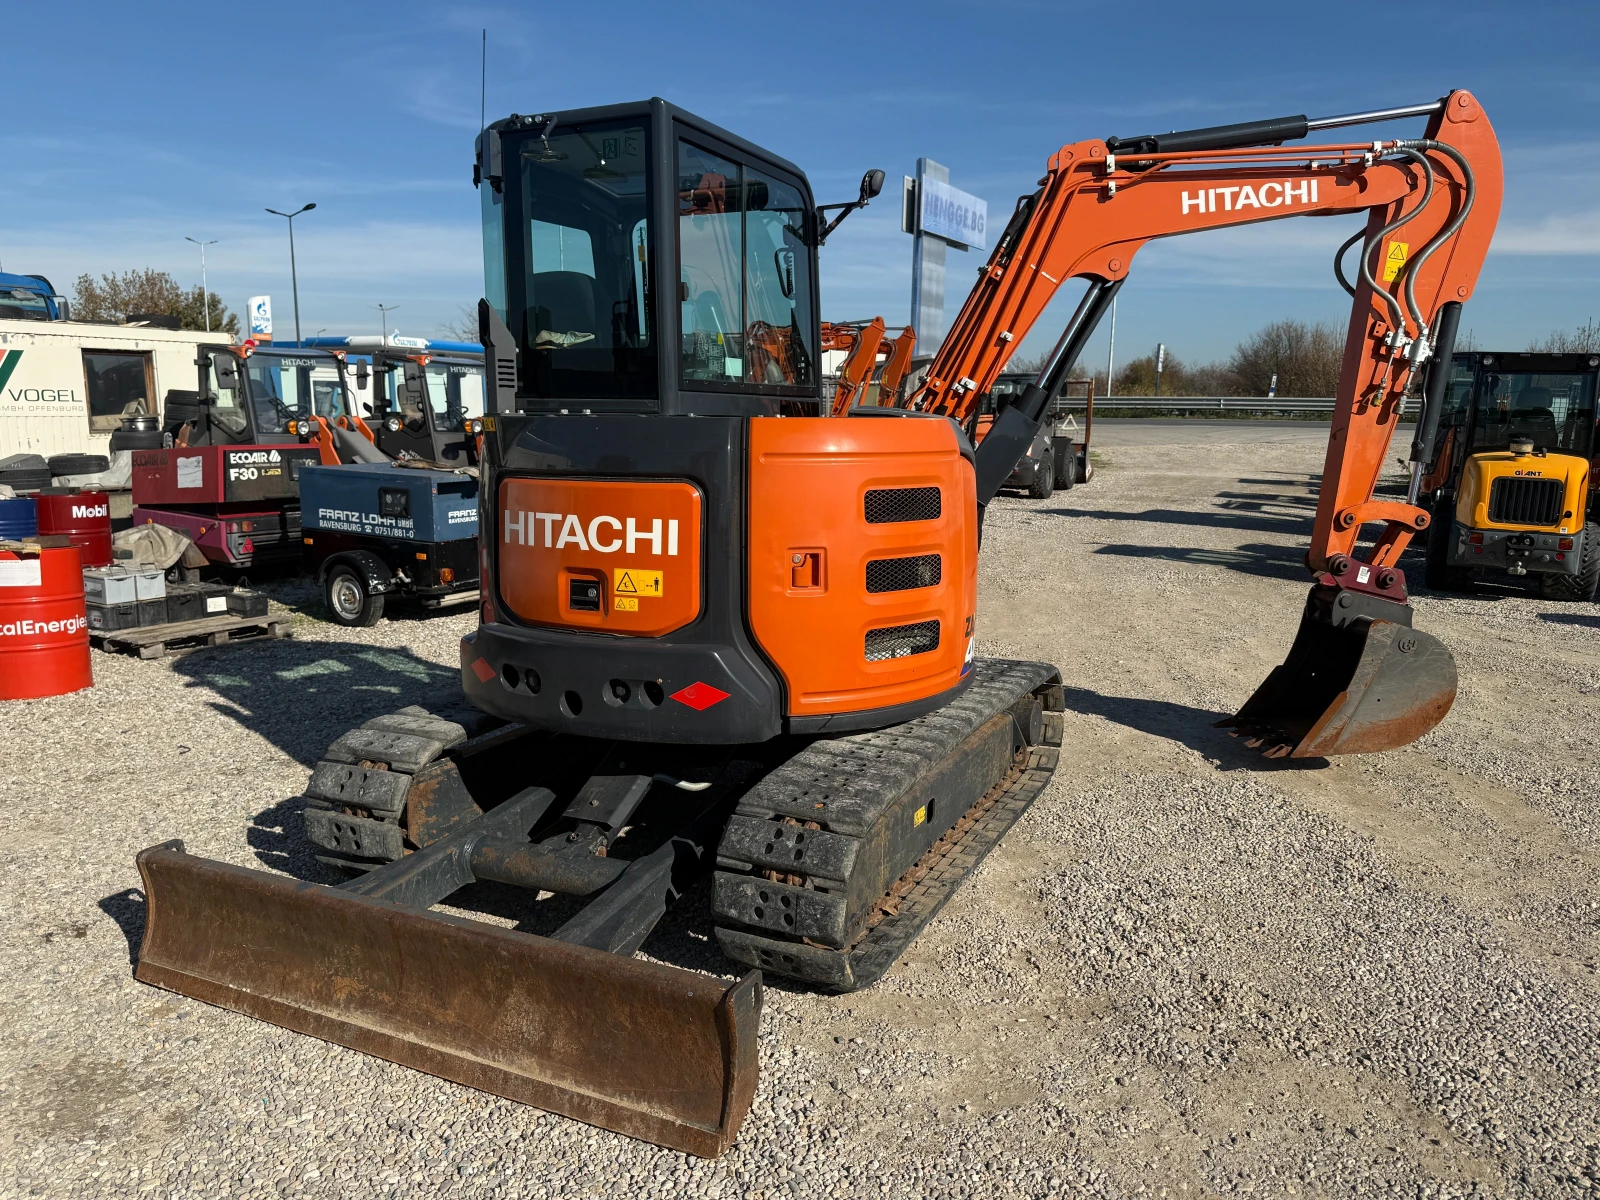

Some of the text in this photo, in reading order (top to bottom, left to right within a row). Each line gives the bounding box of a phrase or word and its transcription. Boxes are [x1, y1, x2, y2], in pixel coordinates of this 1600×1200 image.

[1181, 178, 1319, 215] HITACHI
[925, 191, 985, 234] HENGGE.BG
[281, 358, 317, 366] HITACHI
[450, 366, 477, 374] HITACHI
[8, 388, 83, 403] VOGEL
[229, 452, 268, 464] ECOAIR
[229, 467, 259, 482] F30
[1514, 469, 1543, 477] GIANT
[72, 503, 108, 519] Mobil
[318, 508, 360, 523] FRANZ
[362, 513, 396, 527] LOHR
[448, 508, 477, 518] FRANZ
[319, 519, 414, 539] RAVENSBURG 0751/881-0
[504, 509, 679, 556] HITACHI
